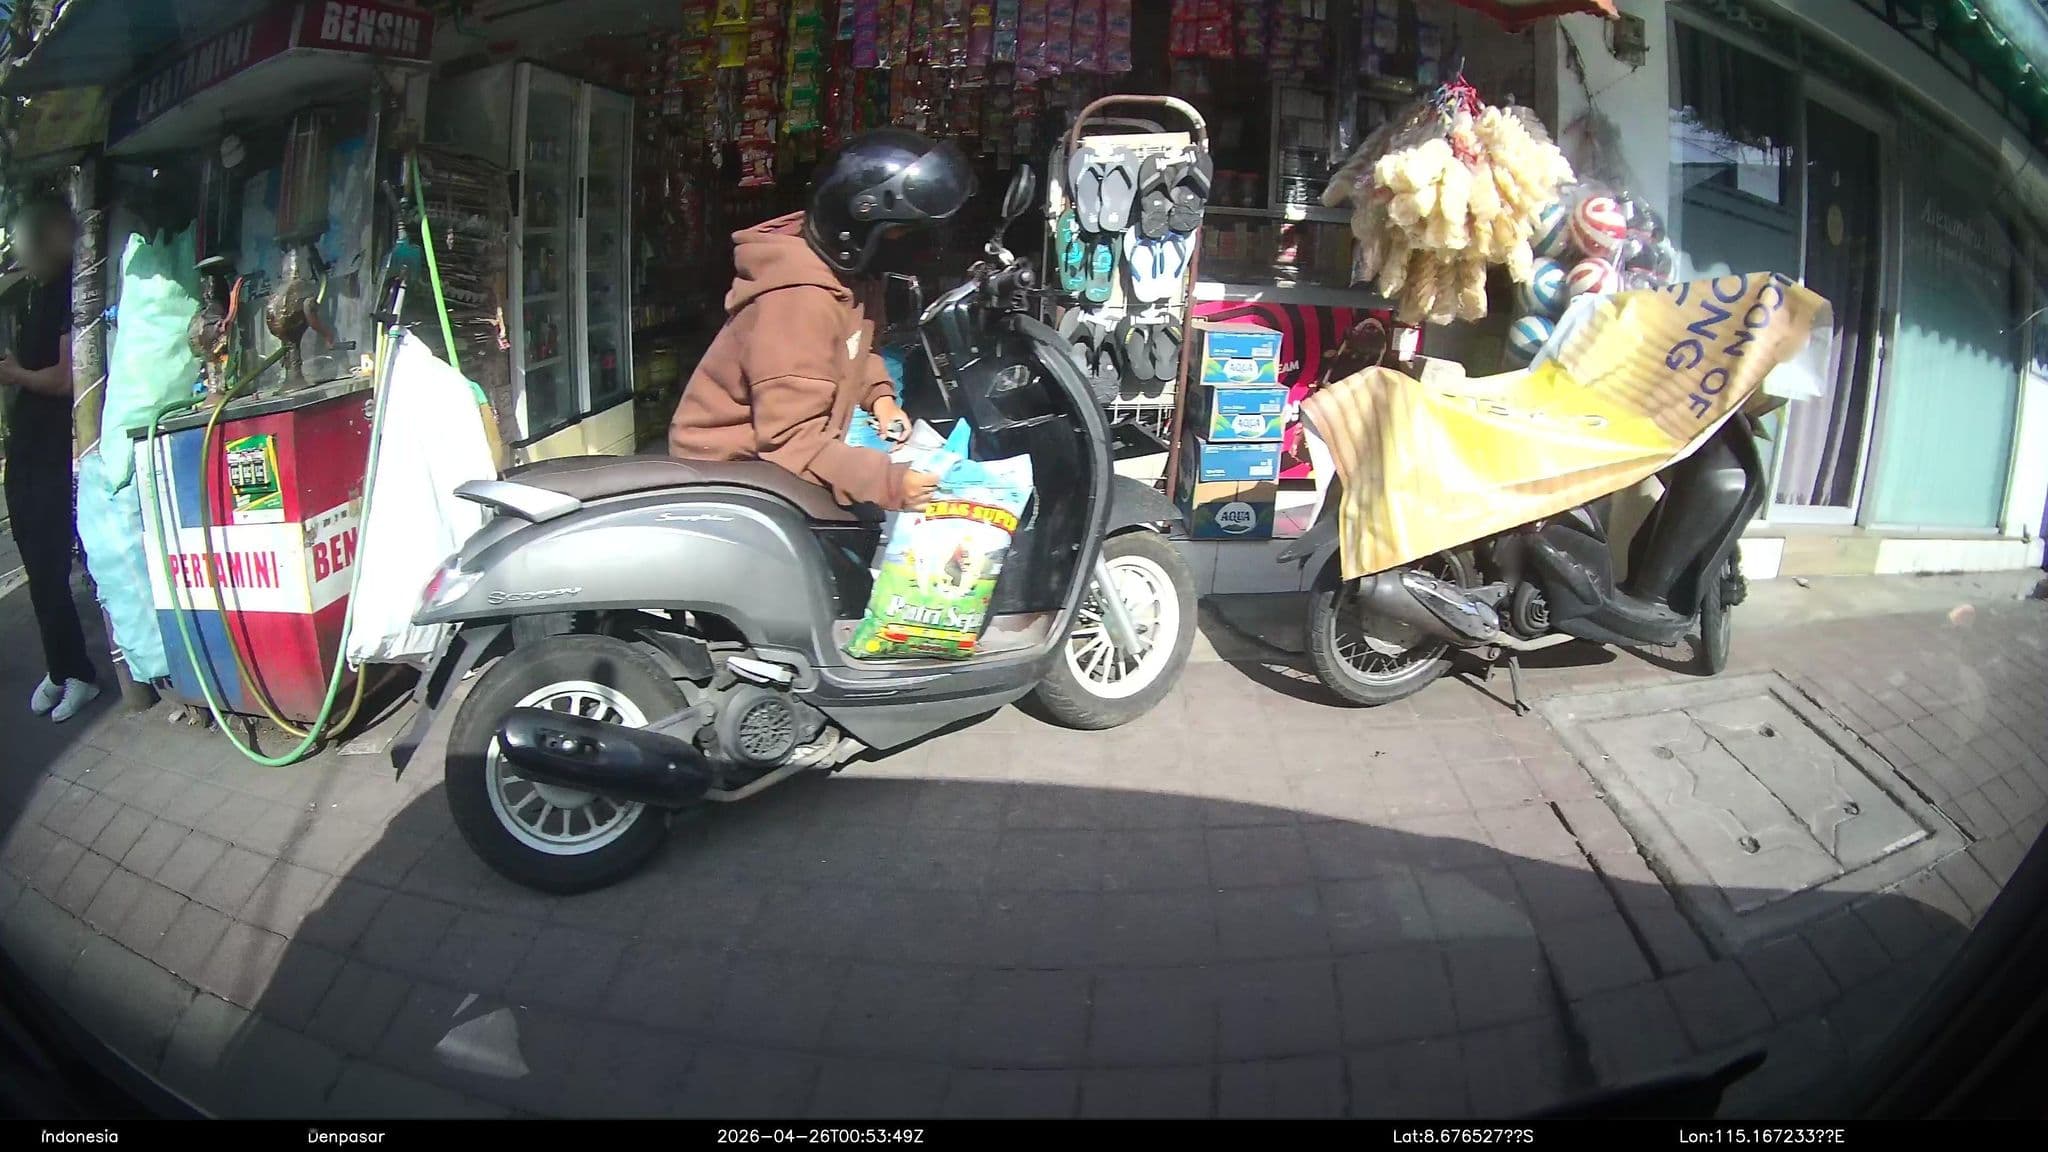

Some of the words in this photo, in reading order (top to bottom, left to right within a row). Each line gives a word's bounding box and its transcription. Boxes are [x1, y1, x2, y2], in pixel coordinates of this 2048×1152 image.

[321, 1, 420, 52] BENSIN
[136, 24, 253, 121] PERTAMINI
[1230, 362, 1254, 374] AQUA
[1688, 367, 1730, 419] OF
[1238, 418, 1261, 429] AQUA
[1220, 511, 1250, 523] AQUA
[169, 551, 280, 588] PERTAMINI
